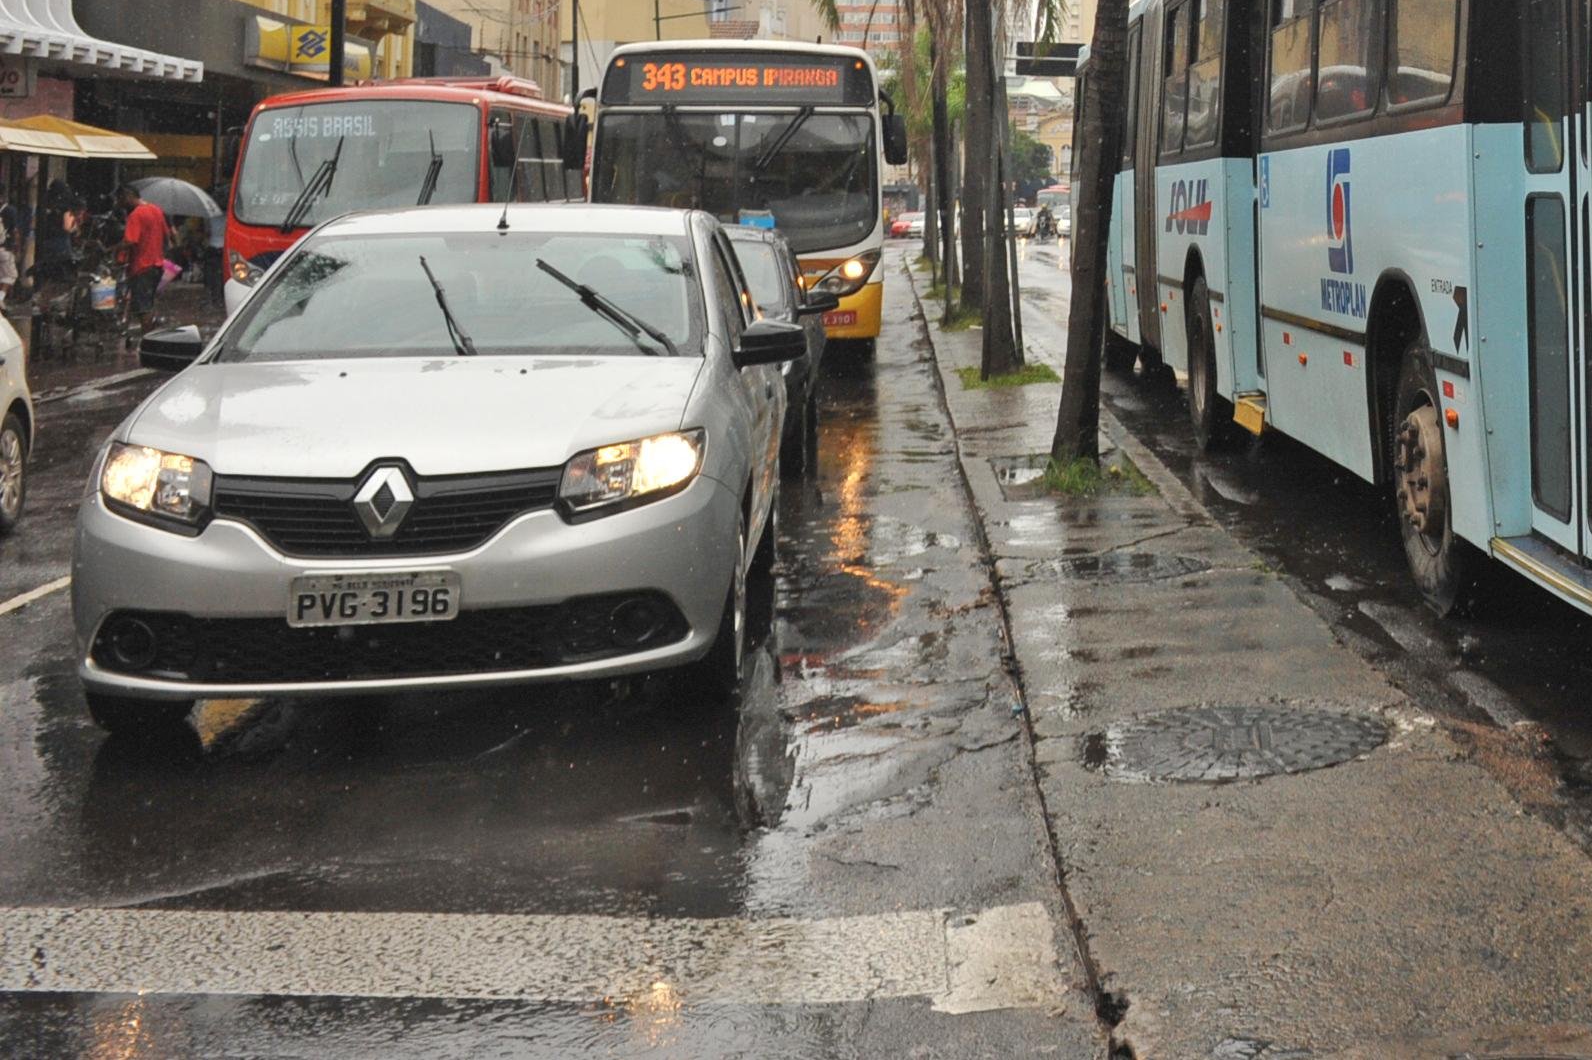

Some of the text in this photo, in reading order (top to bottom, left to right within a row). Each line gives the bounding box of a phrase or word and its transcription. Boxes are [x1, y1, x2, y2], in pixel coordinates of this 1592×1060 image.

[642, 62, 838, 91] 343 CAMPUS IPIRANGA
[273, 115, 376, 139] ASSIS BRASIL
[1320, 277, 1367, 319] METROPLAN
